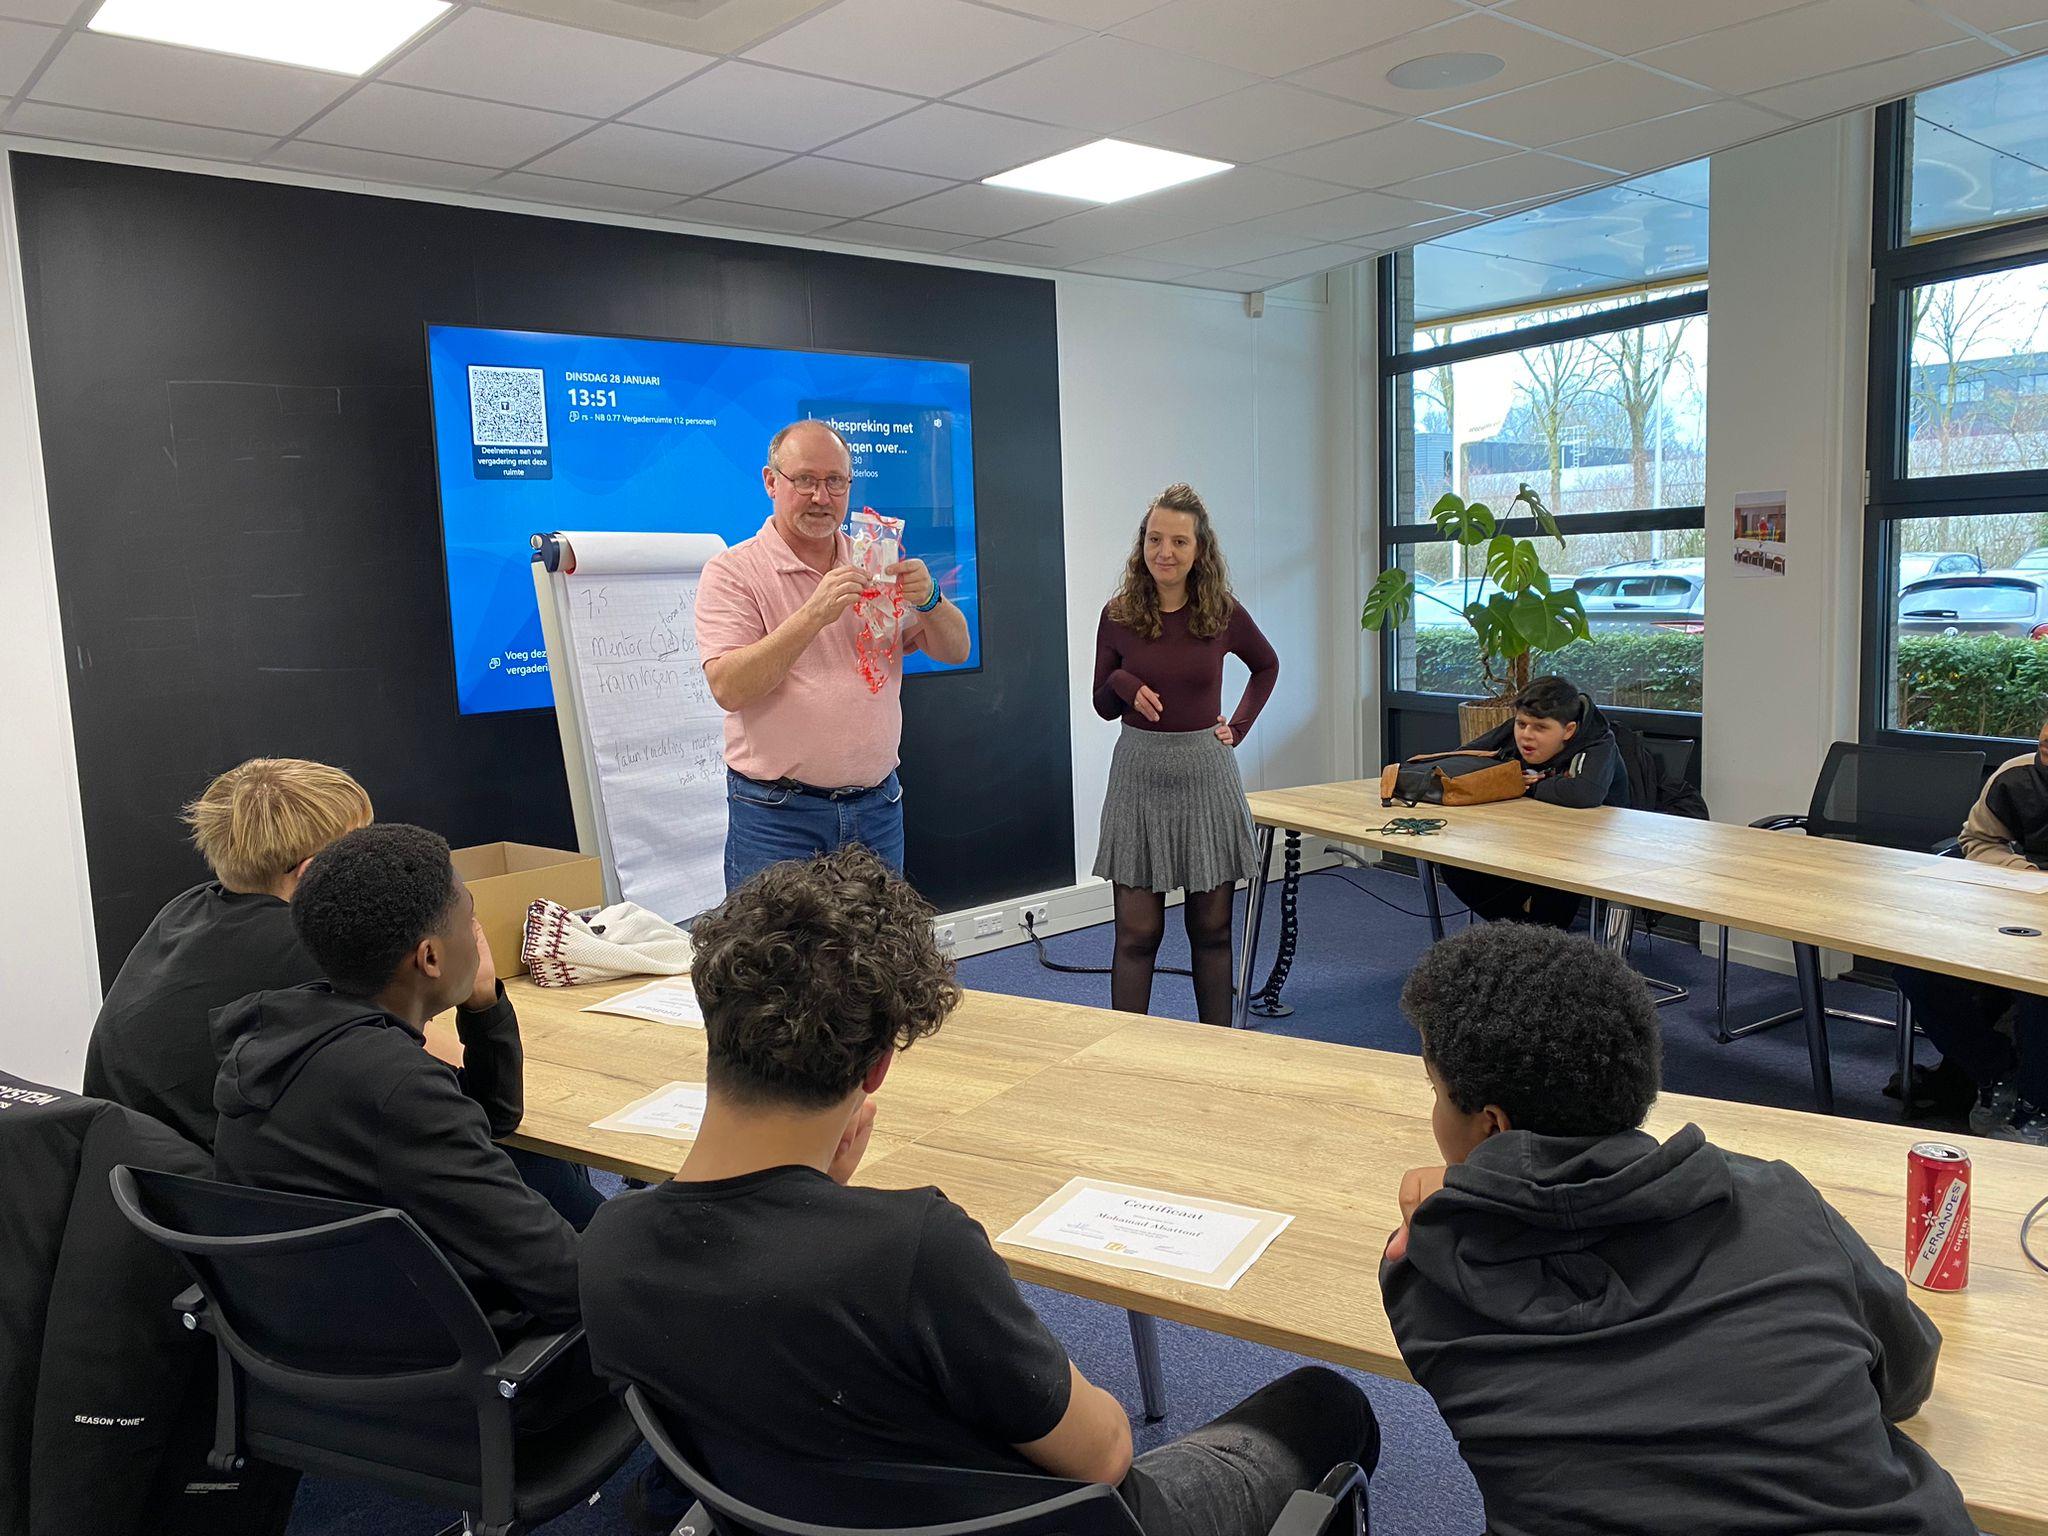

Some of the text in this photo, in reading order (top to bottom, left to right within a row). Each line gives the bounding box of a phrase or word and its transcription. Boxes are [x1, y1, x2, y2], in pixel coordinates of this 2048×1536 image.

[565, 372, 660, 386] DINSDAG 28 JANUARI
[567, 388, 617, 407] 13:51
[594, 413, 606, 421] NB
[606, 414, 621, 422] 0.77
[622, 415, 673, 425] Vergaderruimte
[674, 417, 685, 426] (12
[686, 418, 717, 427] personen)
[892, 422, 914, 434] met
[481, 447, 519, 455] Deelnemen
[875, 443, 908, 454] over...
[477, 458, 548, 467] vergadering met deze
[502, 468, 525, 476] ruimte
[504, 649, 547, 662] Voeg dez
[505, 663, 549, 677] vergaderi
[1123, 1198, 1205, 1221] Certificaat
[1922, 1185, 1962, 1261] FERNANDES
[1953, 1215, 1970, 1252] CHERRY
[74, 1414, 114, 1426] SEASON
